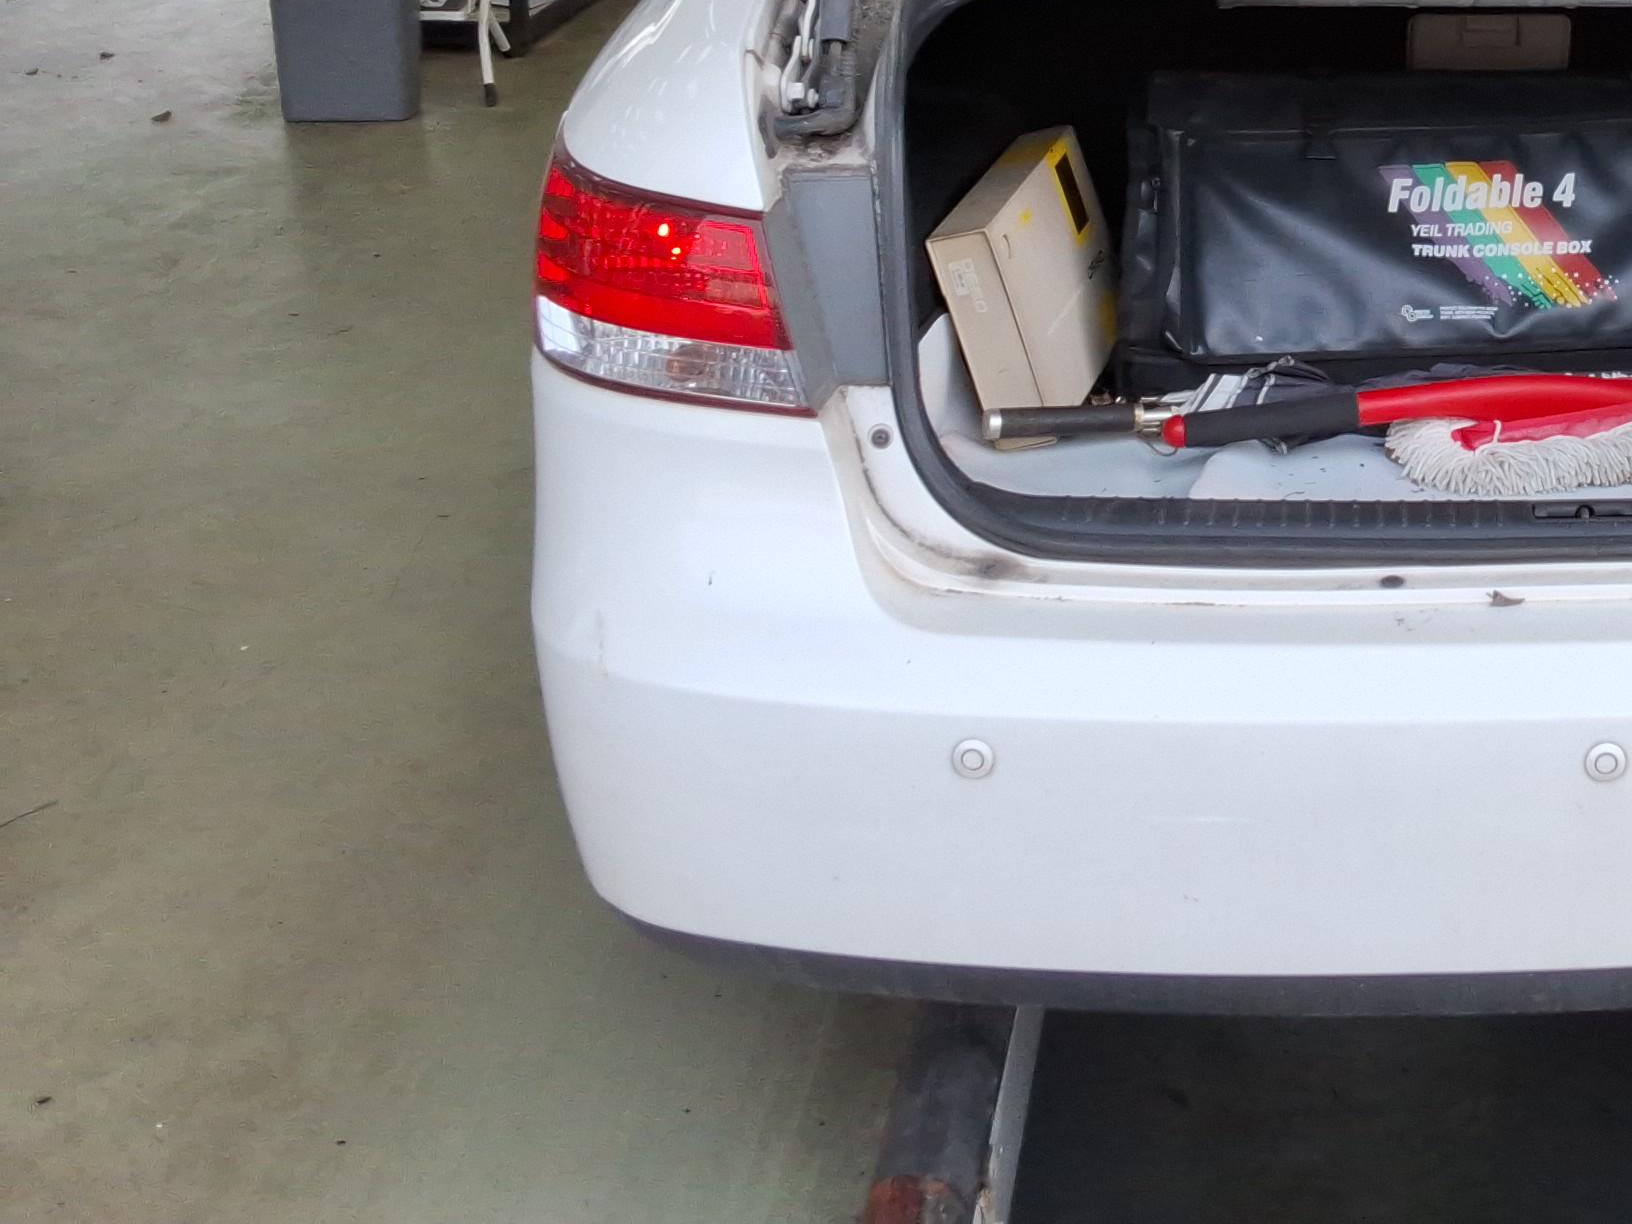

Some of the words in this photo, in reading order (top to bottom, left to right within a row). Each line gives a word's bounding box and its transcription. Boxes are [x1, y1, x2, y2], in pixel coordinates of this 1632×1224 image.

[1387, 173, 1543, 213] Foldable
[1552, 172, 1576, 209] 4
[1410, 224, 1442, 237] YEIL
[1446, 221, 1512, 236] TRADING
[1413, 244, 1469, 258] TRUNK
[1472, 241, 1553, 258] CONSOLE
[1556, 239, 1592, 255] BOX
